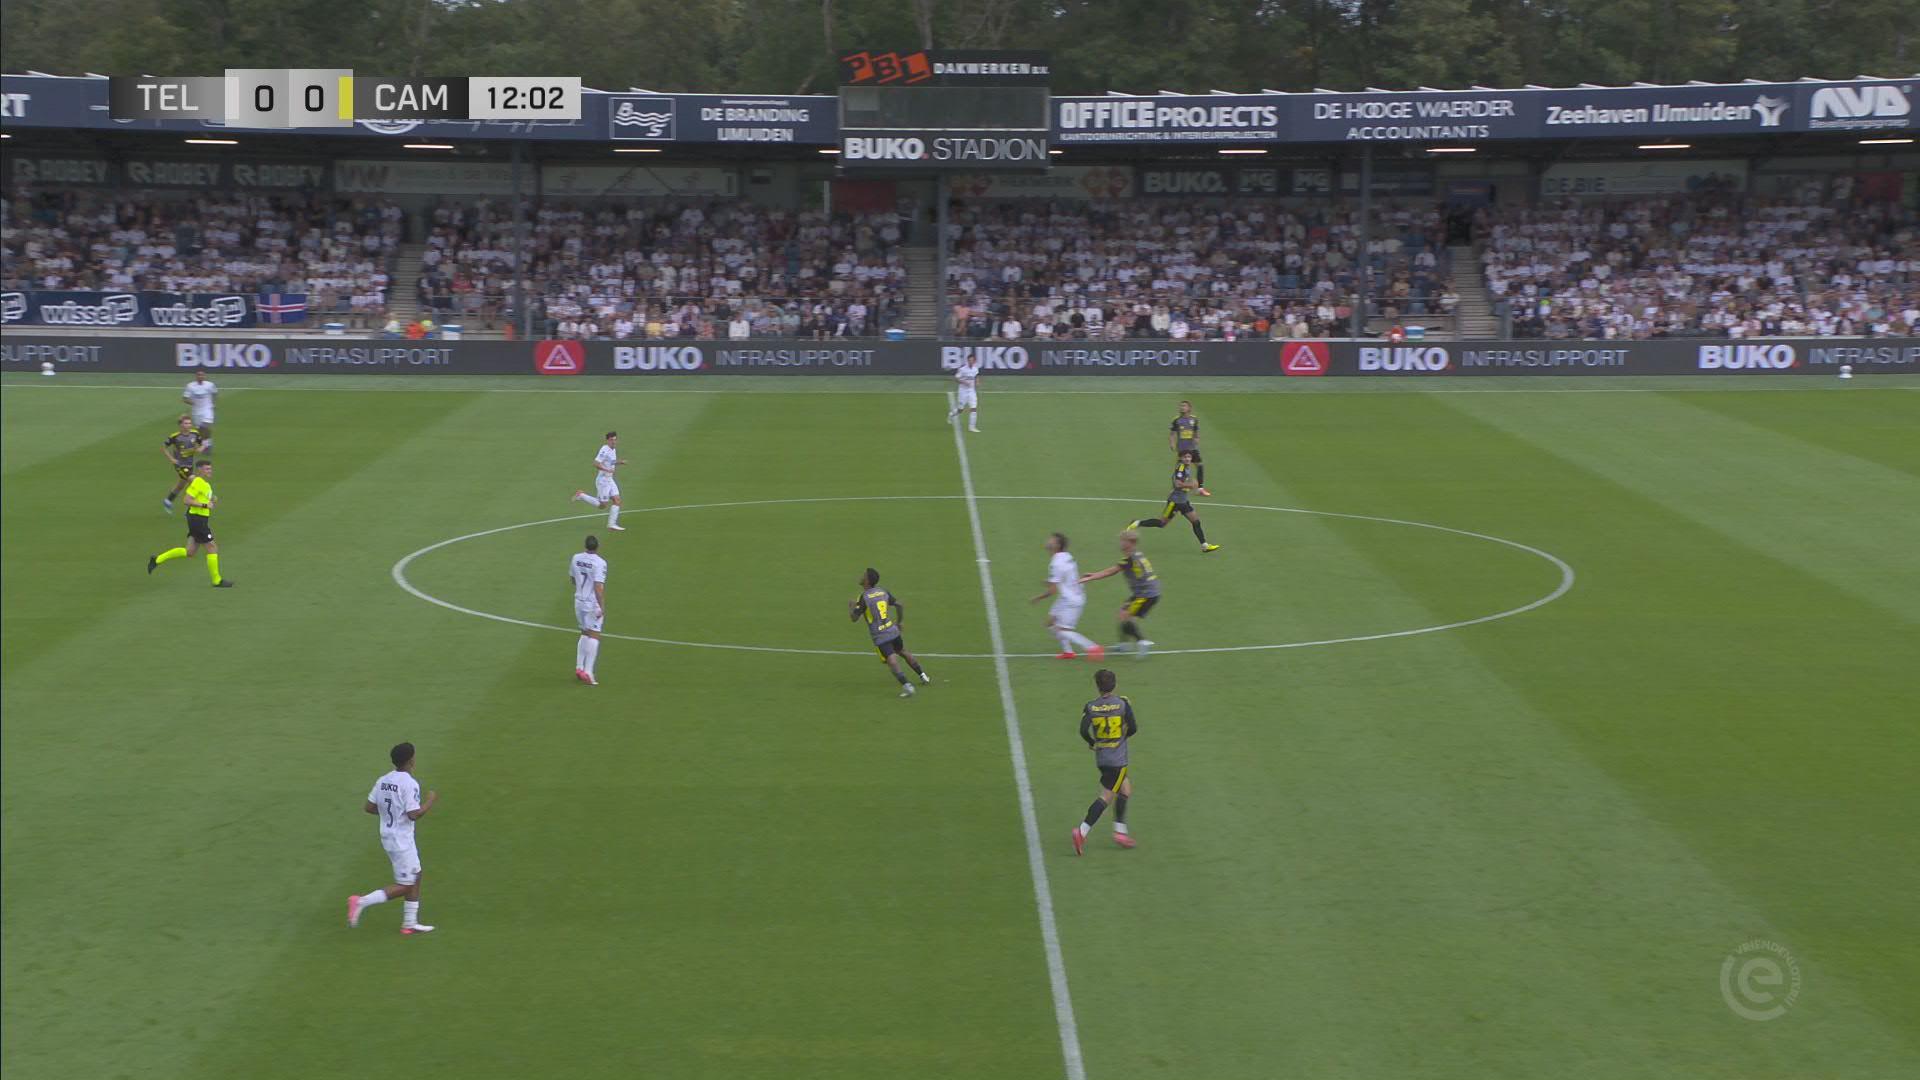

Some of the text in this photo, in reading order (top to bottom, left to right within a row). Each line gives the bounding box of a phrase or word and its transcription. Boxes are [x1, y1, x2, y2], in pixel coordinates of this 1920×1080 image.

[933, 63, 1031, 75] DAKWERKEN
[701, 108, 810, 122] DE BRANDING
[1314, 100, 1515, 119] DE HOOGE WAERDER
[1546, 105, 1649, 125] Zeehaven
[1346, 125, 1490, 140] ACCOUNTANTS
[932, 137, 1046, 160] STADION
[285, 347, 453, 365] INFRASUPPORT
[715, 350, 876, 367] INFRASUPPORT
[1041, 349, 1201, 366] INFRASUPPORT
[1462, 349, 1628, 367] INFRASUPPORT
[580, 572, 588, 590] 7
[385, 798, 394, 828] 3
